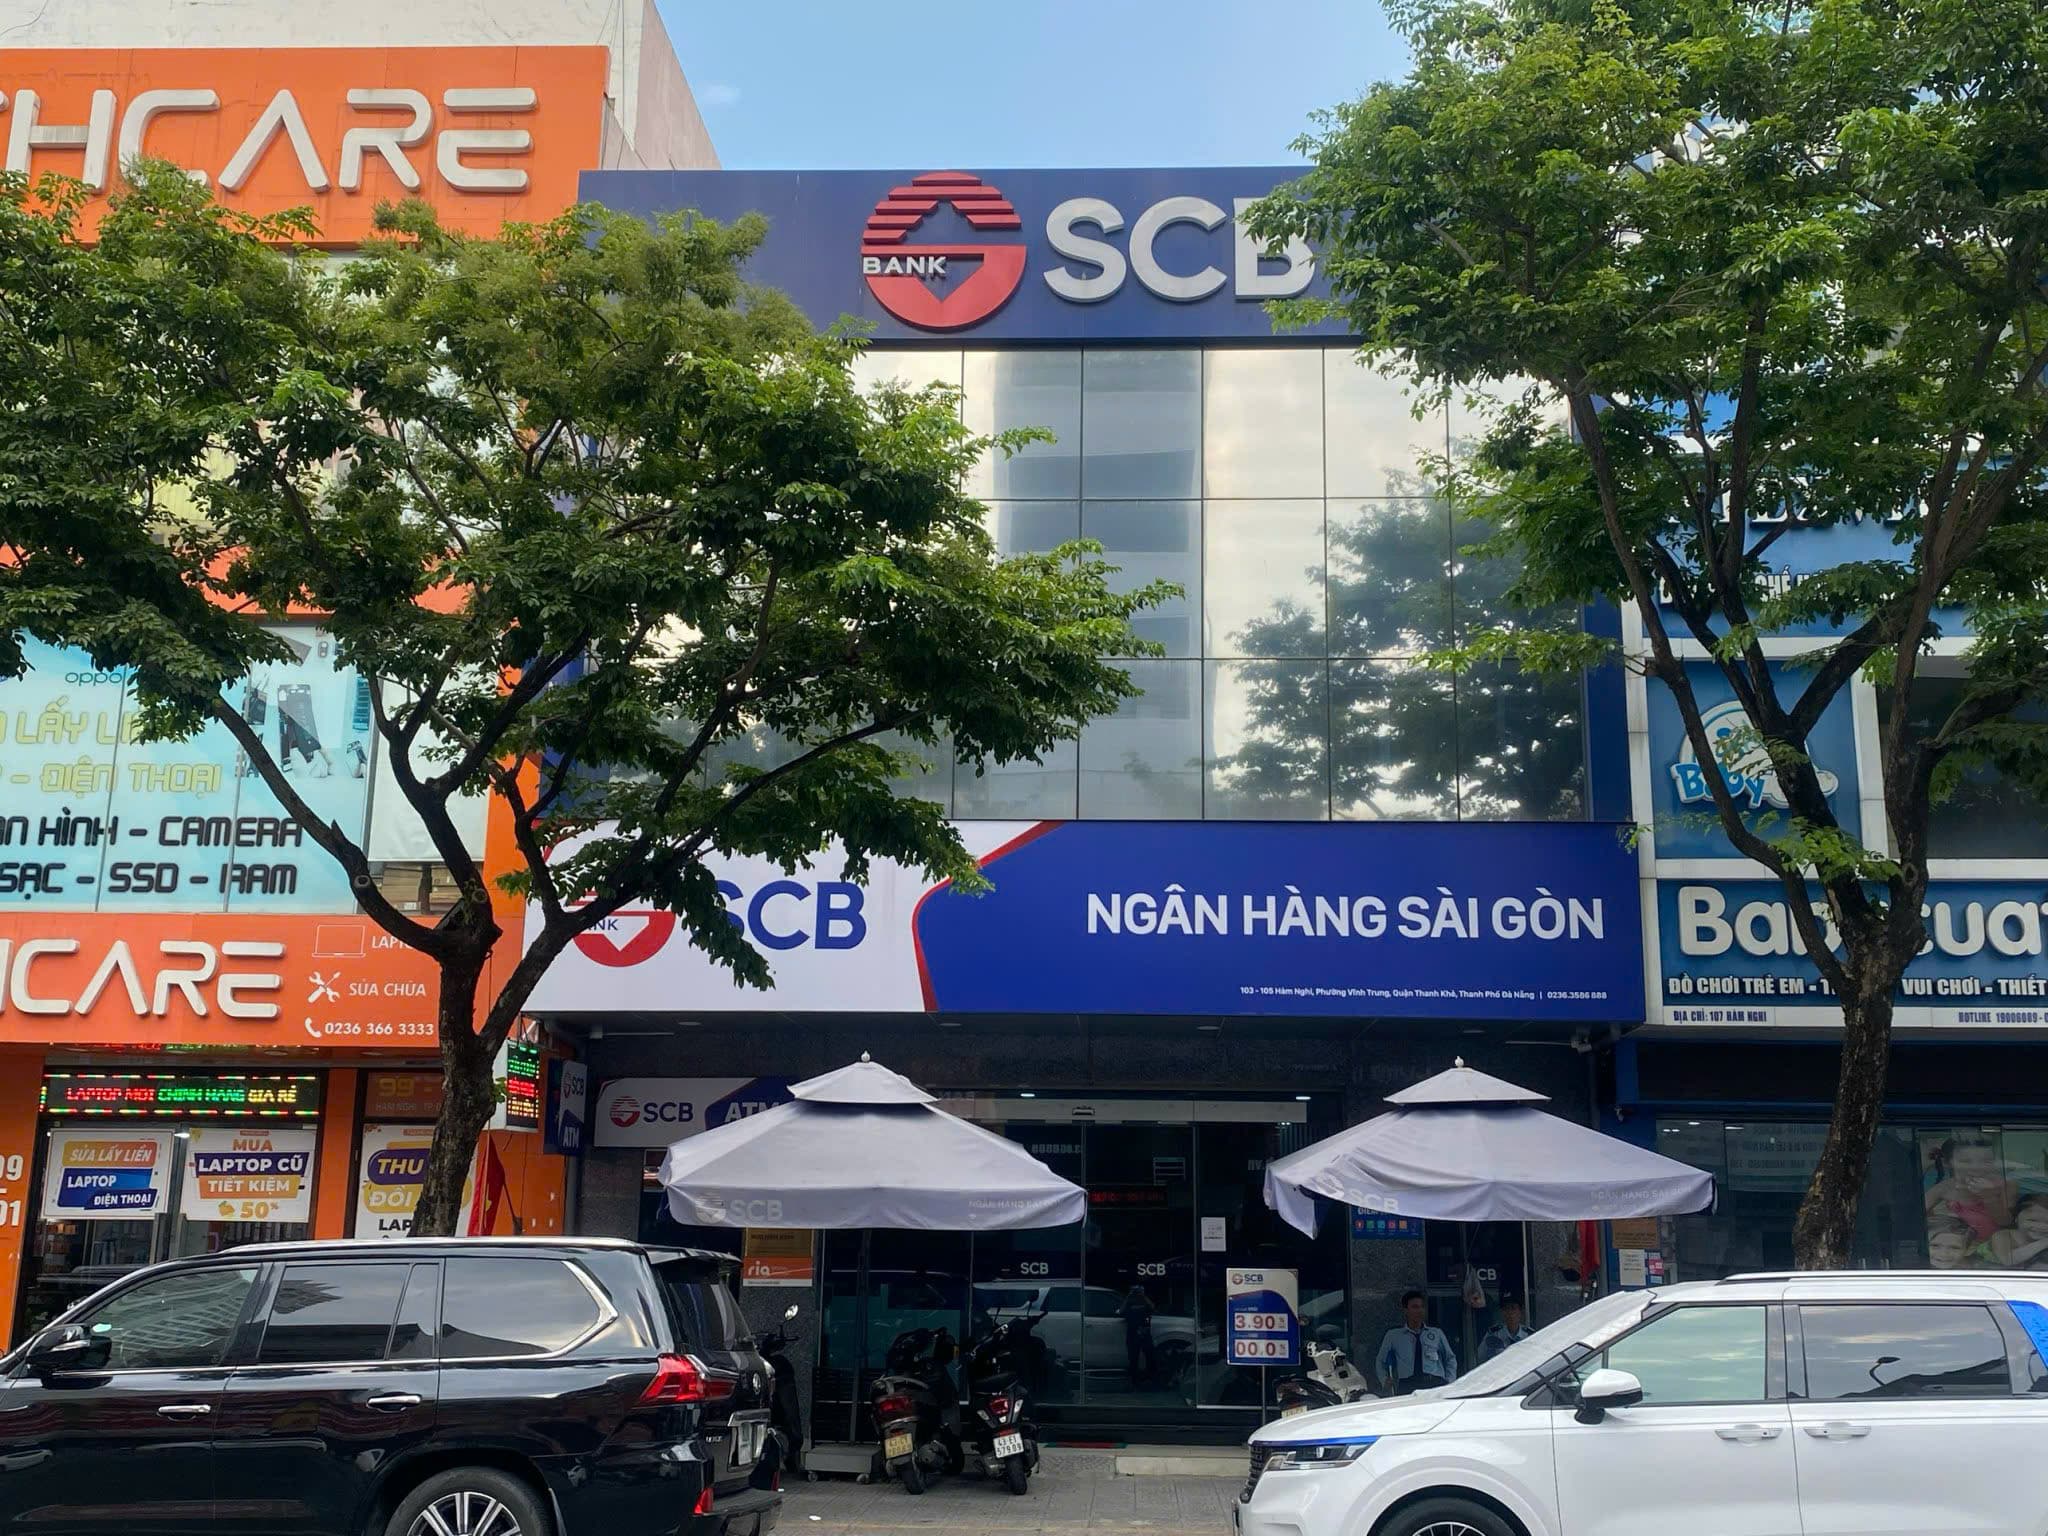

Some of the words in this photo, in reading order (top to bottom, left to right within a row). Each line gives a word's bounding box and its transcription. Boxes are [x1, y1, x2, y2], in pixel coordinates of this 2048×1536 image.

[0, 87, 539, 193] HCARE
[1044, 197, 1316, 301] SCB
[863, 256, 947, 276] BANK
[65, 671, 123, 686] oppo
[16, 695, 89, 744] LẤY
[40, 755, 117, 798] ĐIỆN
[129, 763, 222, 798] THOẠI
[38, 806, 118, 846] HÌNH
[159, 816, 302, 847] CAMERA
[0, 862, 66, 900] SẠC
[108, 862, 179, 893] SSD
[219, 864, 298, 894] RAM
[1087, 884, 1228, 935] NGÂN
[1243, 885, 1387, 938] HÀNG
[1398, 887, 1479, 939] SÀI
[1491, 887, 1604, 940] GÒN
[1240, 986, 1253, 994] 103
[1260, 987, 1273, 995] 105
[1415, 989, 1439, 997] Thanh
[1459, 990, 1484, 998] Thanh
[1668, 974, 1693, 994] ĐỒ
[1697, 976, 1739, 994] CHƠI
[1743, 974, 1775, 994] TRẺ
[1779, 977, 1805, 994] EM
[1902, 978, 1933, 996] VUI
[1937, 976, 1981, 996] CHƠI
[1998, 972, 2047, 996] THIẾT
[1959, 1012, 1992, 1023] HOTLINE
[324, 1022, 361, 1035] 0236
[366, 1022, 393, 1035] 366
[398, 1022, 434, 1036] 3333
[643, 1101, 694, 1123] SCB
[233, 1139, 273, 1151] MUA
[0, 1154, 23, 1181] 9
[199, 1158, 272, 1172] LAPTOP
[277, 1155, 303, 1171] CŨ
[378, 1158, 425, 1174] THU
[67, 1175, 117, 1188] LAPTOP
[94, 1193, 118, 1207] ĐIỆN
[121, 1193, 151, 1206] THOẠI
[730, 1199, 783, 1221] SCB
[1020, 1262, 1049, 1275] SCB
[1137, 1263, 1166, 1276] SCB
[1476, 1268, 1497, 1280] CB
[1244, 1274, 1263, 1282] SCB
[1235, 1314, 1275, 1329] 3.90
[1236, 1341, 1276, 1356] 00.0
